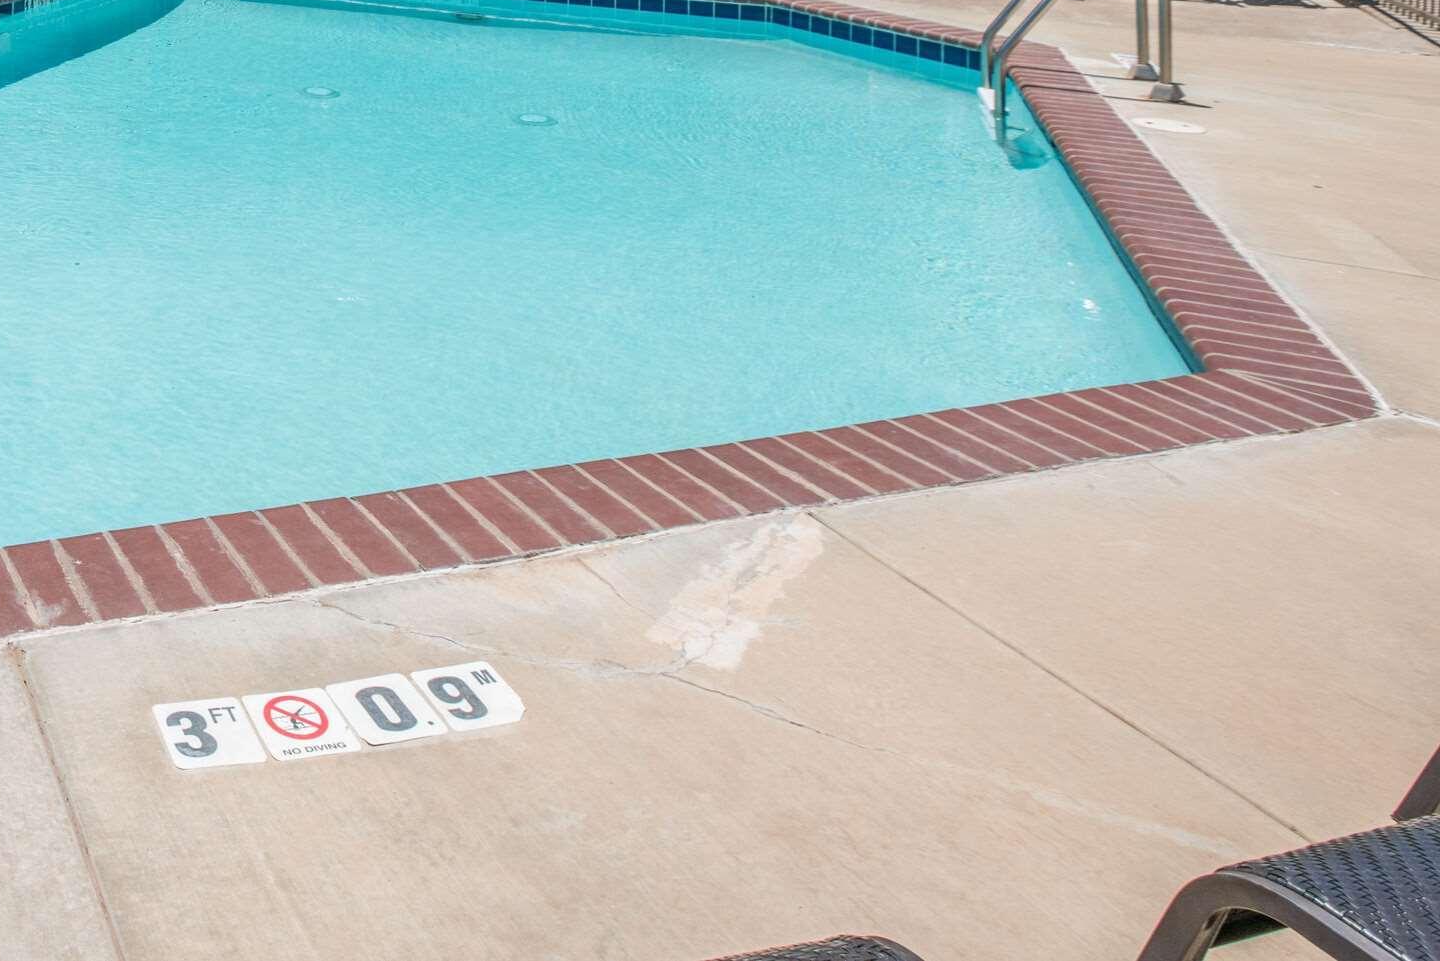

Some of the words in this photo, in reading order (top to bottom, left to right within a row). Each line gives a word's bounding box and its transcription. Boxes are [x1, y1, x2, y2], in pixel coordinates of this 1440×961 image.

[165, 710, 219, 758] 3
[206, 705, 238, 724] FT
[282, 746, 302, 757] NO
[304, 741, 348, 754] DIVING
